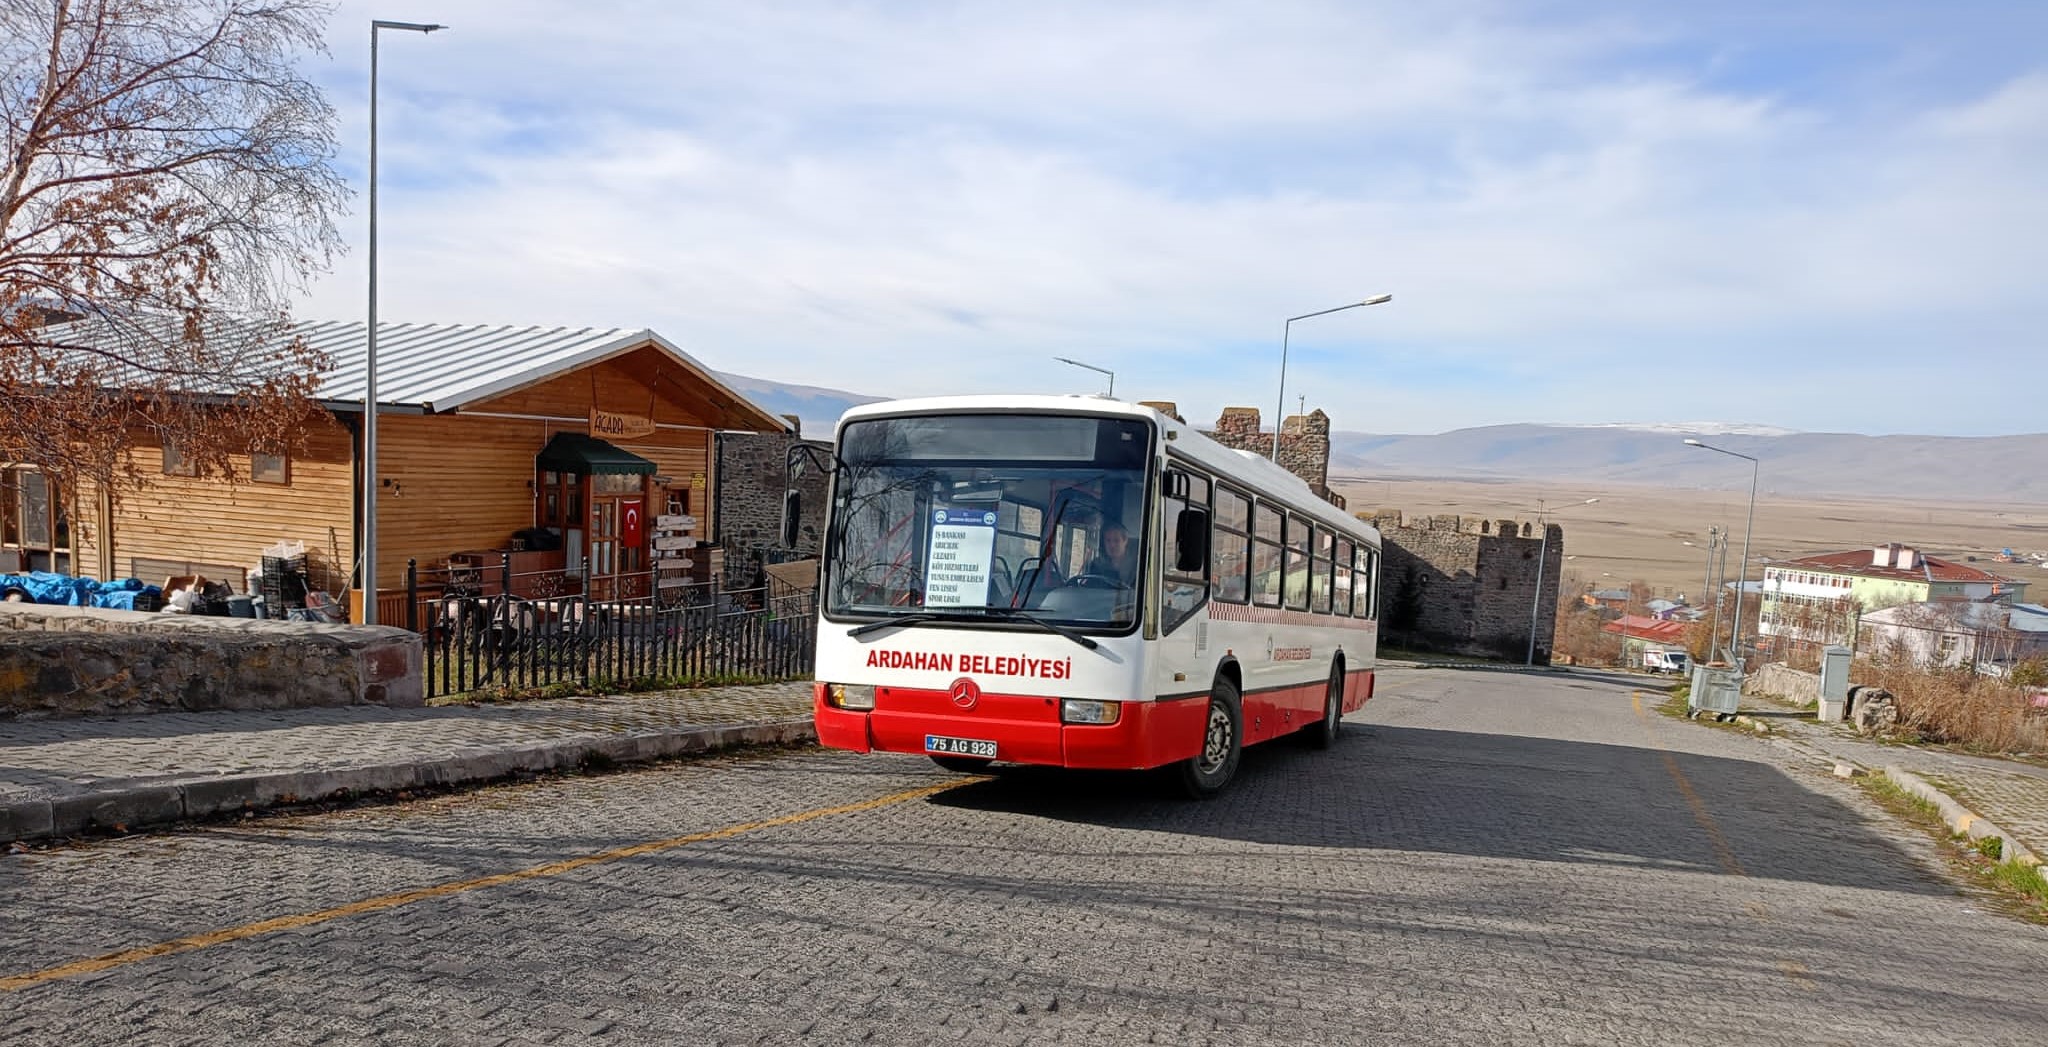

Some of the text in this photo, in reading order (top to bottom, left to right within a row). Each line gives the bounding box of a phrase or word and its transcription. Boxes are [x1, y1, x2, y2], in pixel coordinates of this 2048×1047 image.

[866, 650, 1071, 680] ARDAHAN BELEDİYESİ
[932, 738, 994, 756] 75 AG 928
